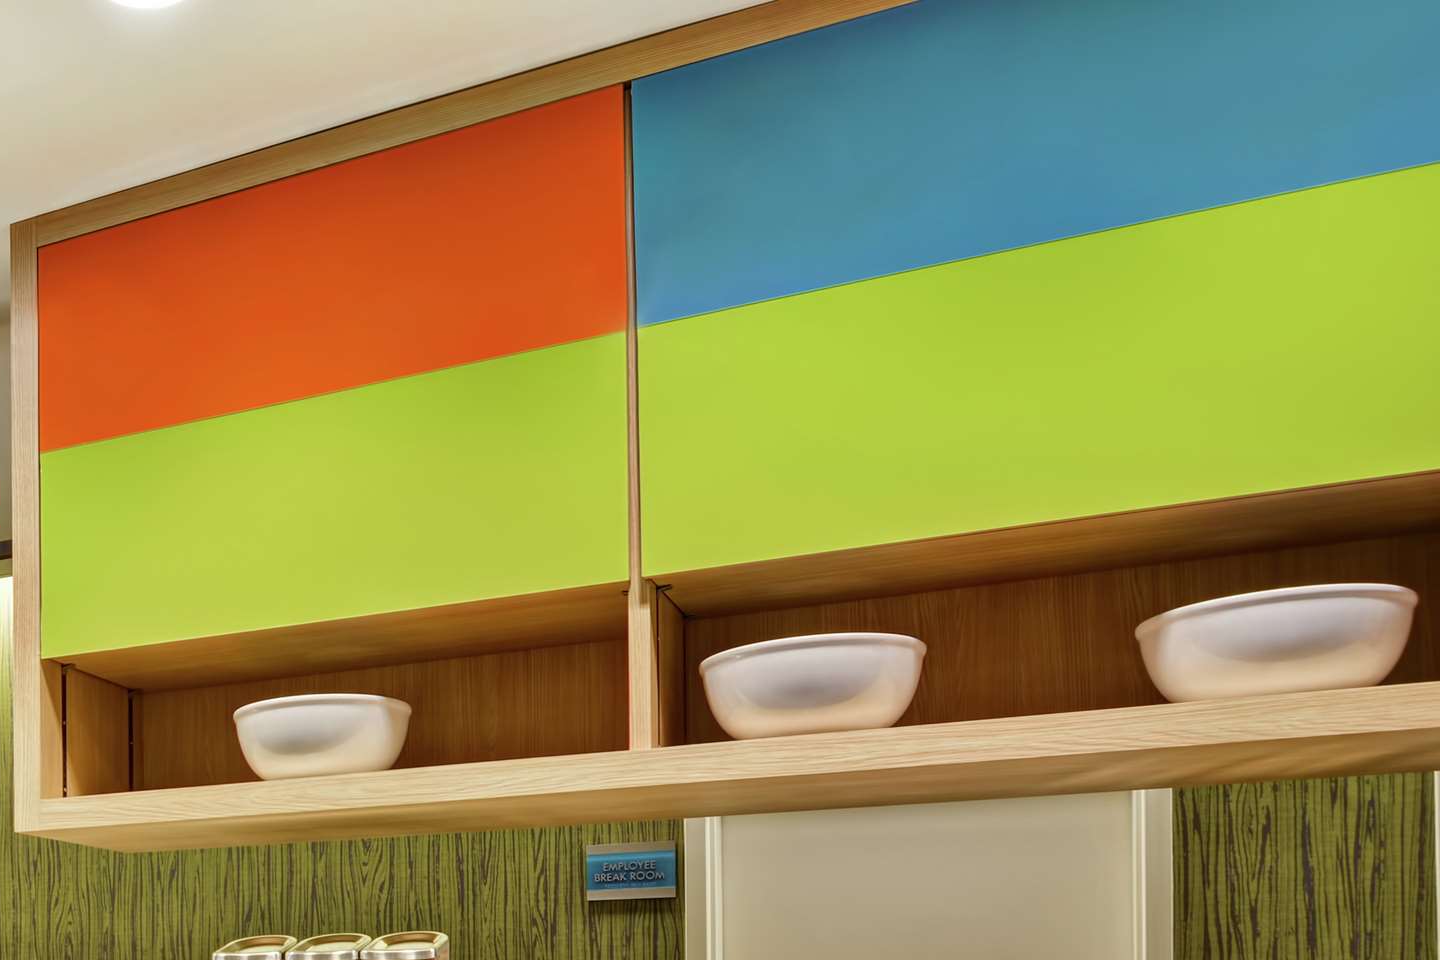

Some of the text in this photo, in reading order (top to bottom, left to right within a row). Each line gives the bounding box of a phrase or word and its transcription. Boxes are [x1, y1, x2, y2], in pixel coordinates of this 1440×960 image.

[602, 860, 657, 872] EMPLOYEE
[594, 870, 665, 883] BREAK ROOM
